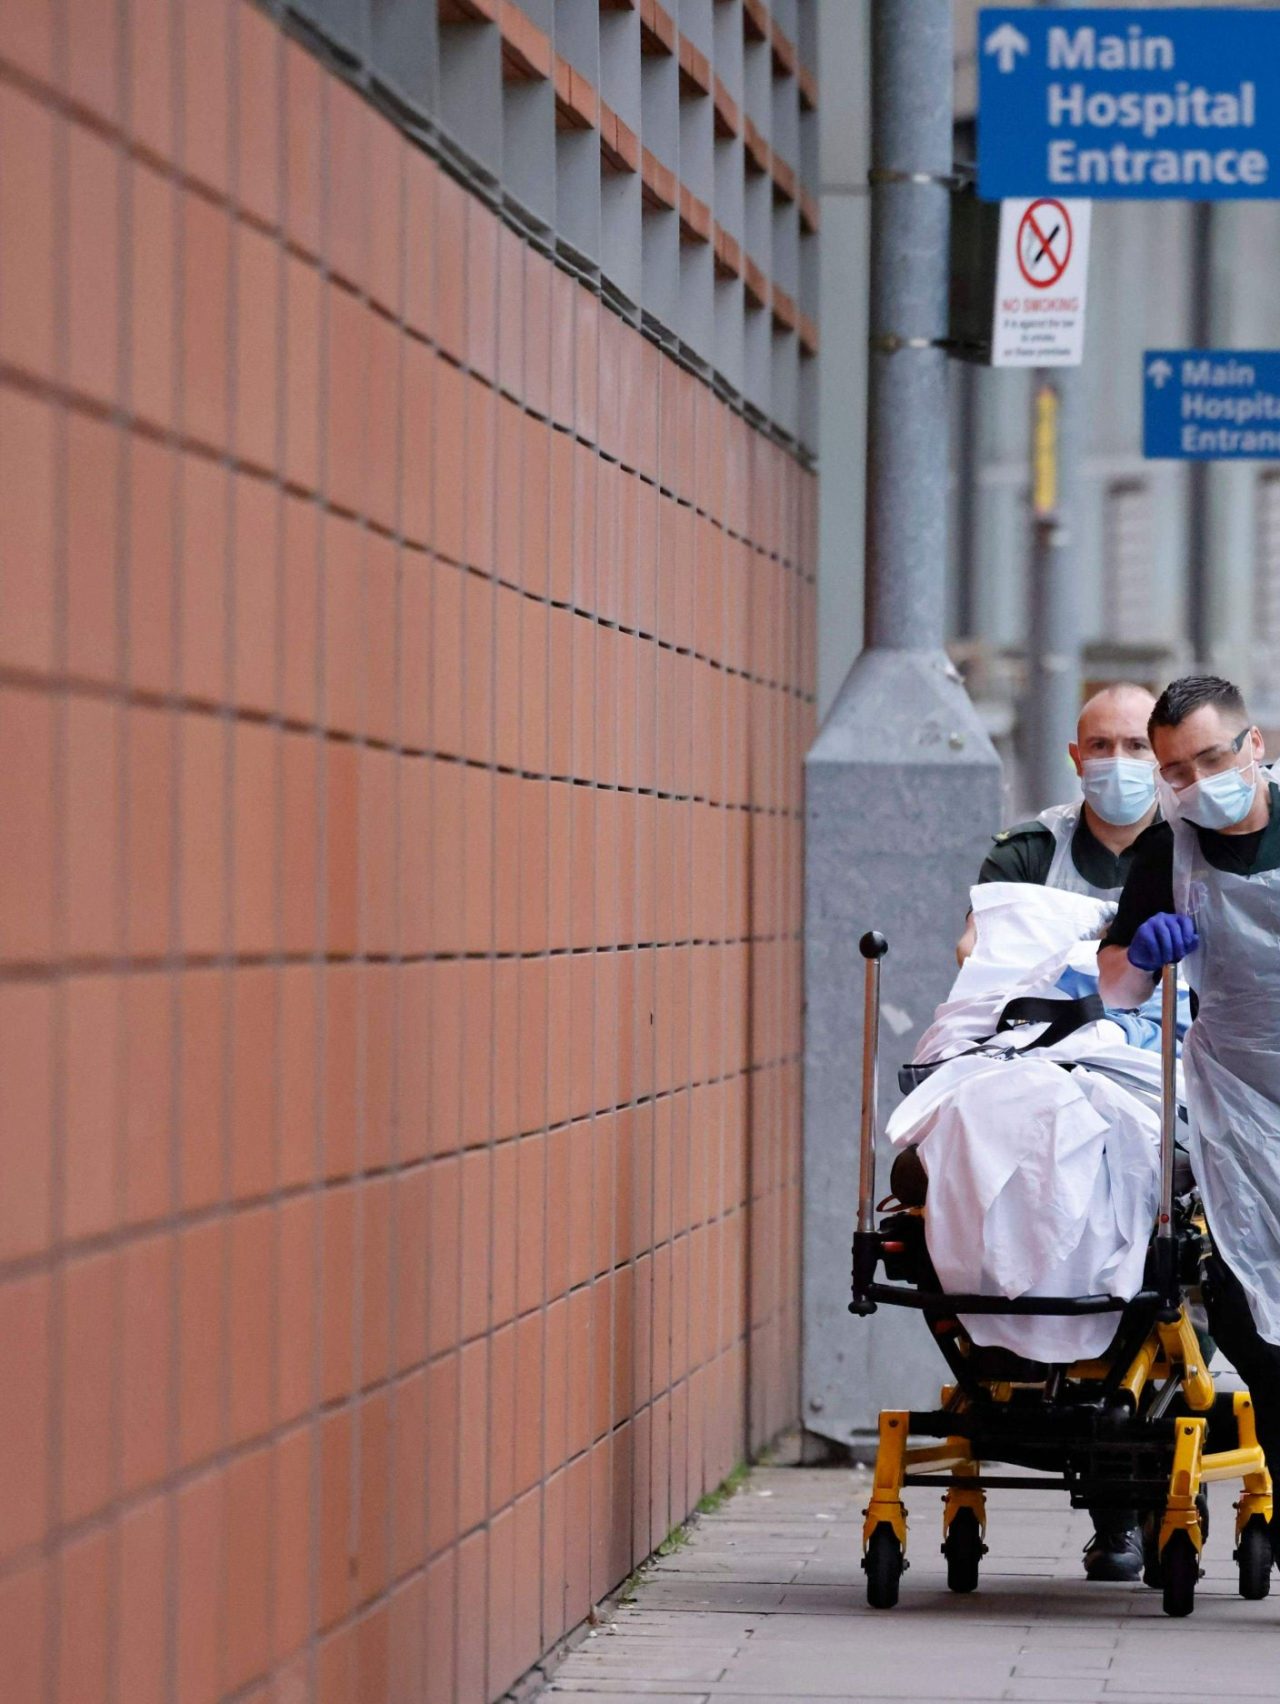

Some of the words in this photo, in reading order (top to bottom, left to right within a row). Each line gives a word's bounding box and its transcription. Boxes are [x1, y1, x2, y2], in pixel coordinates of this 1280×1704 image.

[1047, 26, 1174, 69] Main
[1047, 83, 1256, 136] Hospital
[1047, 141, 1268, 184] Entrance
[1181, 360, 1256, 387] Main
